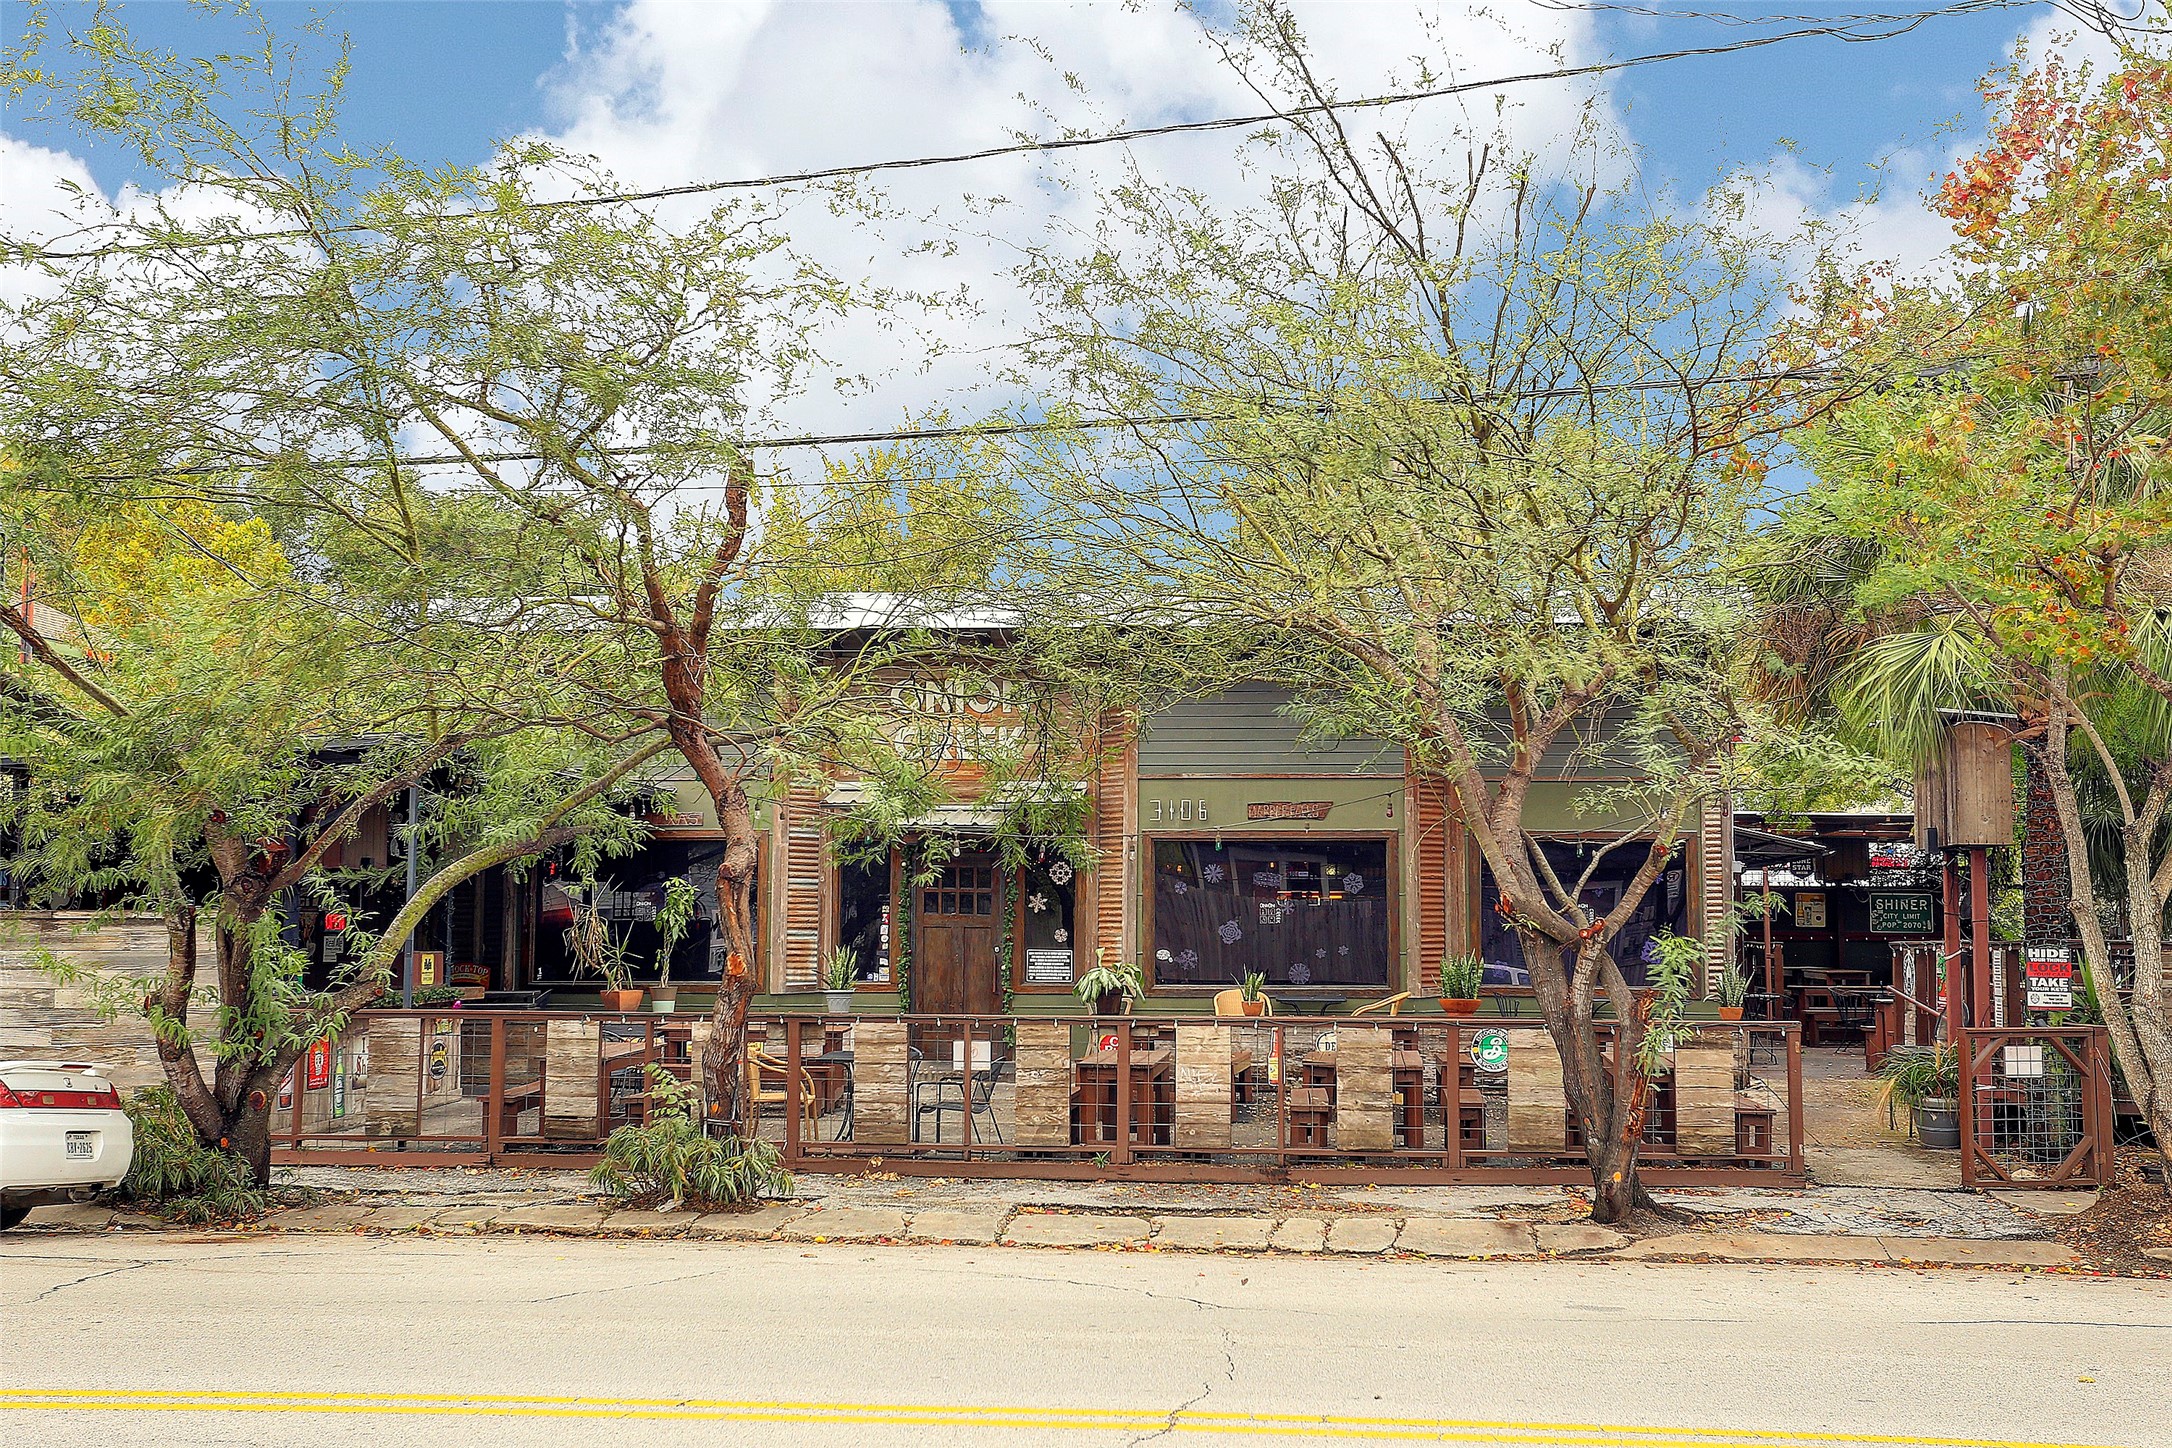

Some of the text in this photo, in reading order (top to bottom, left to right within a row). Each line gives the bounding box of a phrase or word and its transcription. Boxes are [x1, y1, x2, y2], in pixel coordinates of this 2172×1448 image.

[1149, 799, 1207, 821] 3106
[1876, 898, 1928, 911] SHINER
[1882, 912, 1898, 920] CITY
[1902, 921, 1922, 929] 2070
[2028, 948, 2070, 958] HIDE
[472, 965, 489, 976] TOP
[2029, 963, 2070, 973] LOCK
[2029, 977, 2069, 988] TAKE
